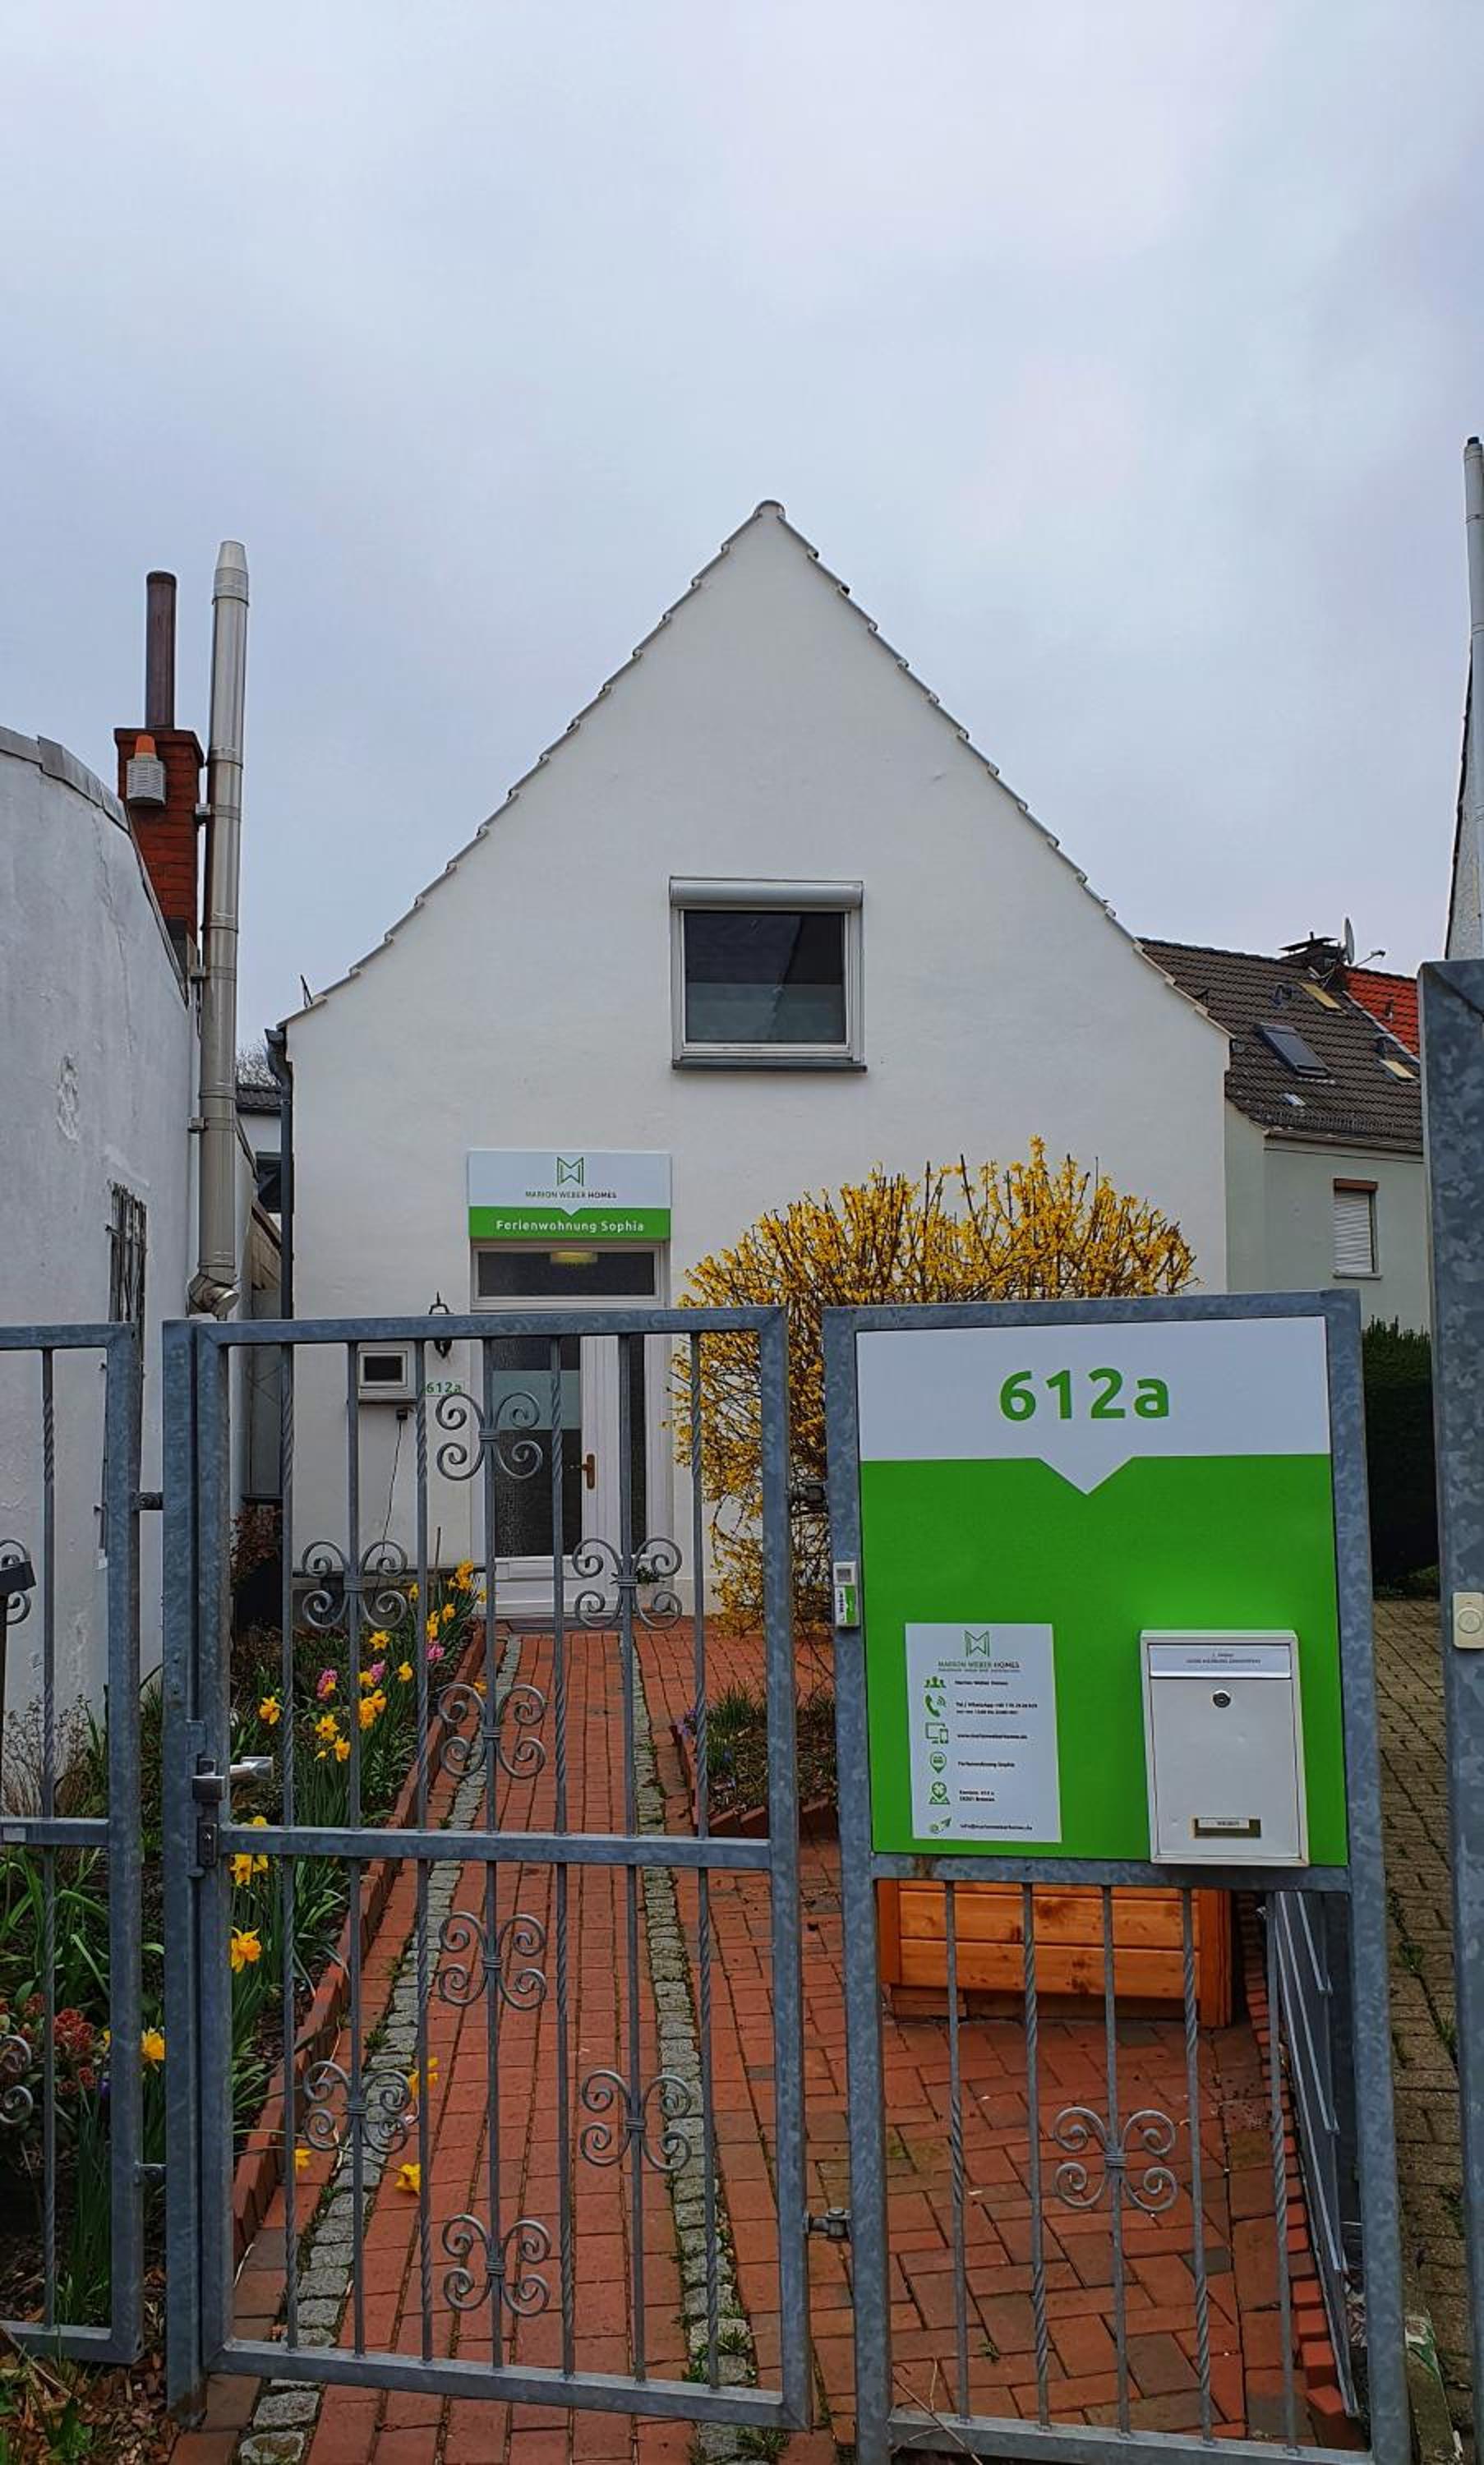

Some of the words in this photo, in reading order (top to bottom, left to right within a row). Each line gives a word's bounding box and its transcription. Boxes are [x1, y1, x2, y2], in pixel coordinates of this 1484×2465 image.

[496, 1219, 597, 1233] Ferienwohnung
[601, 1220, 644, 1233] Sophia
[999, 1367, 1170, 1421] 612a
